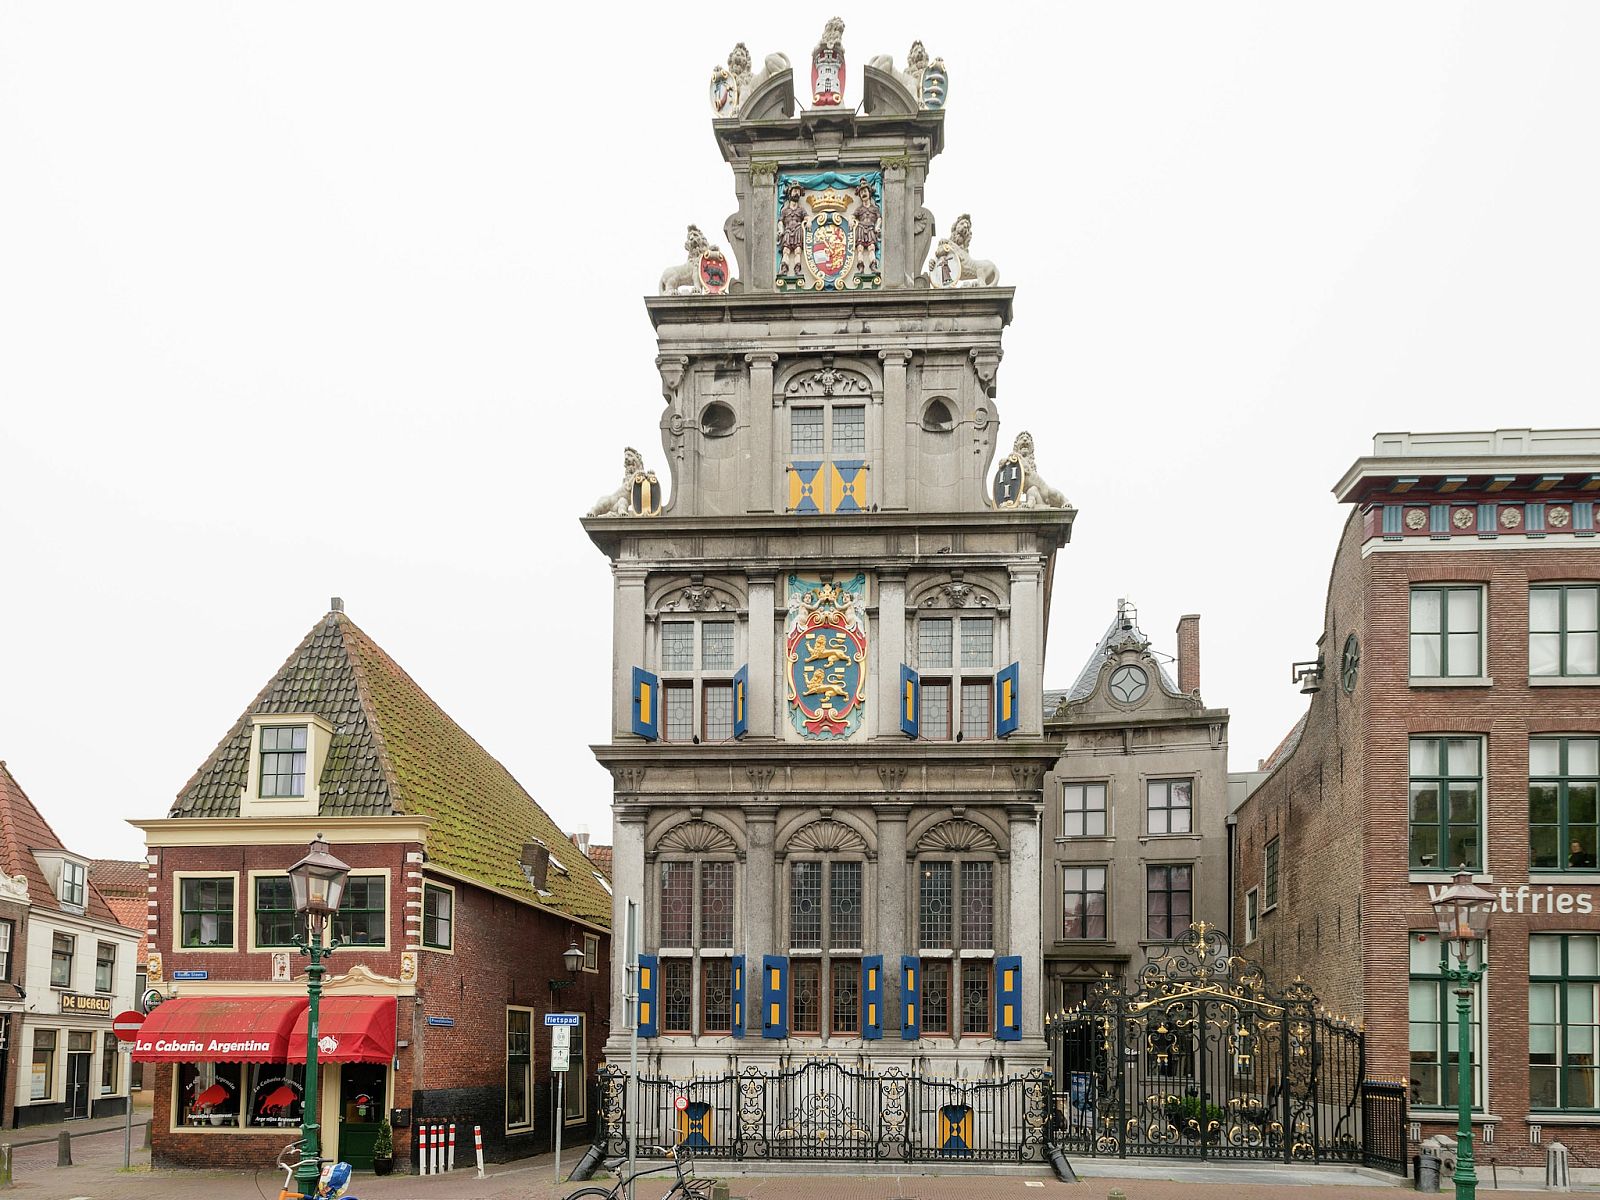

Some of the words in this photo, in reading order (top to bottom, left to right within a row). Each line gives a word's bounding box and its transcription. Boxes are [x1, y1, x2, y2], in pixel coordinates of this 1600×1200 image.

[1428, 885, 1593, 914] Wstfries
[63, 995, 75, 1008] DE
[77, 996, 110, 1010] WERELD
[547, 1016, 577, 1024] fietspad
[136, 1040, 152, 1051] La
[155, 1040, 204, 1051] Cabaña
[207, 1040, 270, 1053] Argentina
